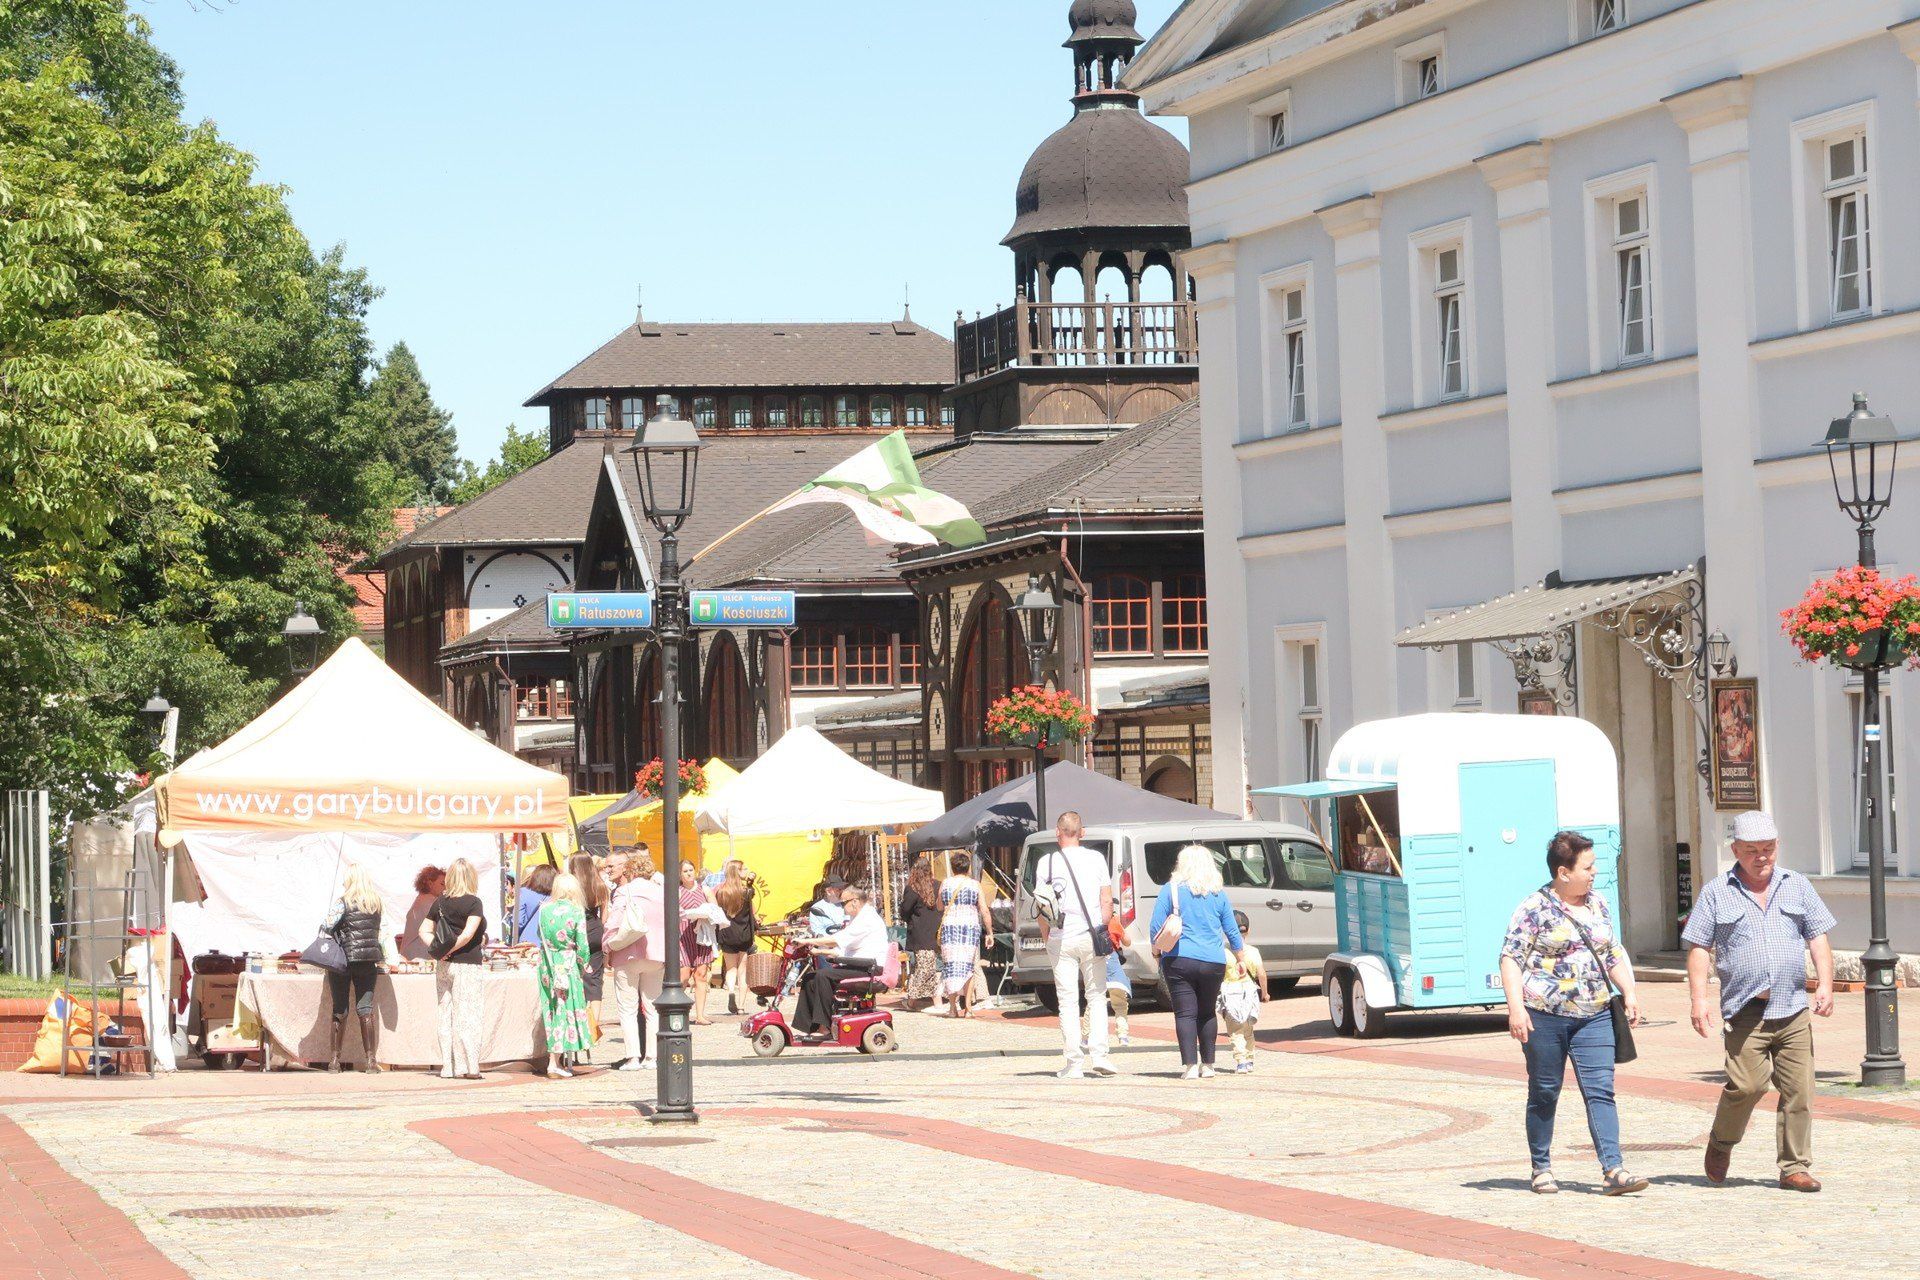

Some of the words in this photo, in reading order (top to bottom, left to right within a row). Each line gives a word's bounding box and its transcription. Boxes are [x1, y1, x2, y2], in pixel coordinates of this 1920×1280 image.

[579, 606, 643, 619] Ratuszowa
[722, 605, 787, 619] Kościuszki
[196, 787, 542, 819] www.garybulgary.pl
[671, 1054, 684, 1064] 33
